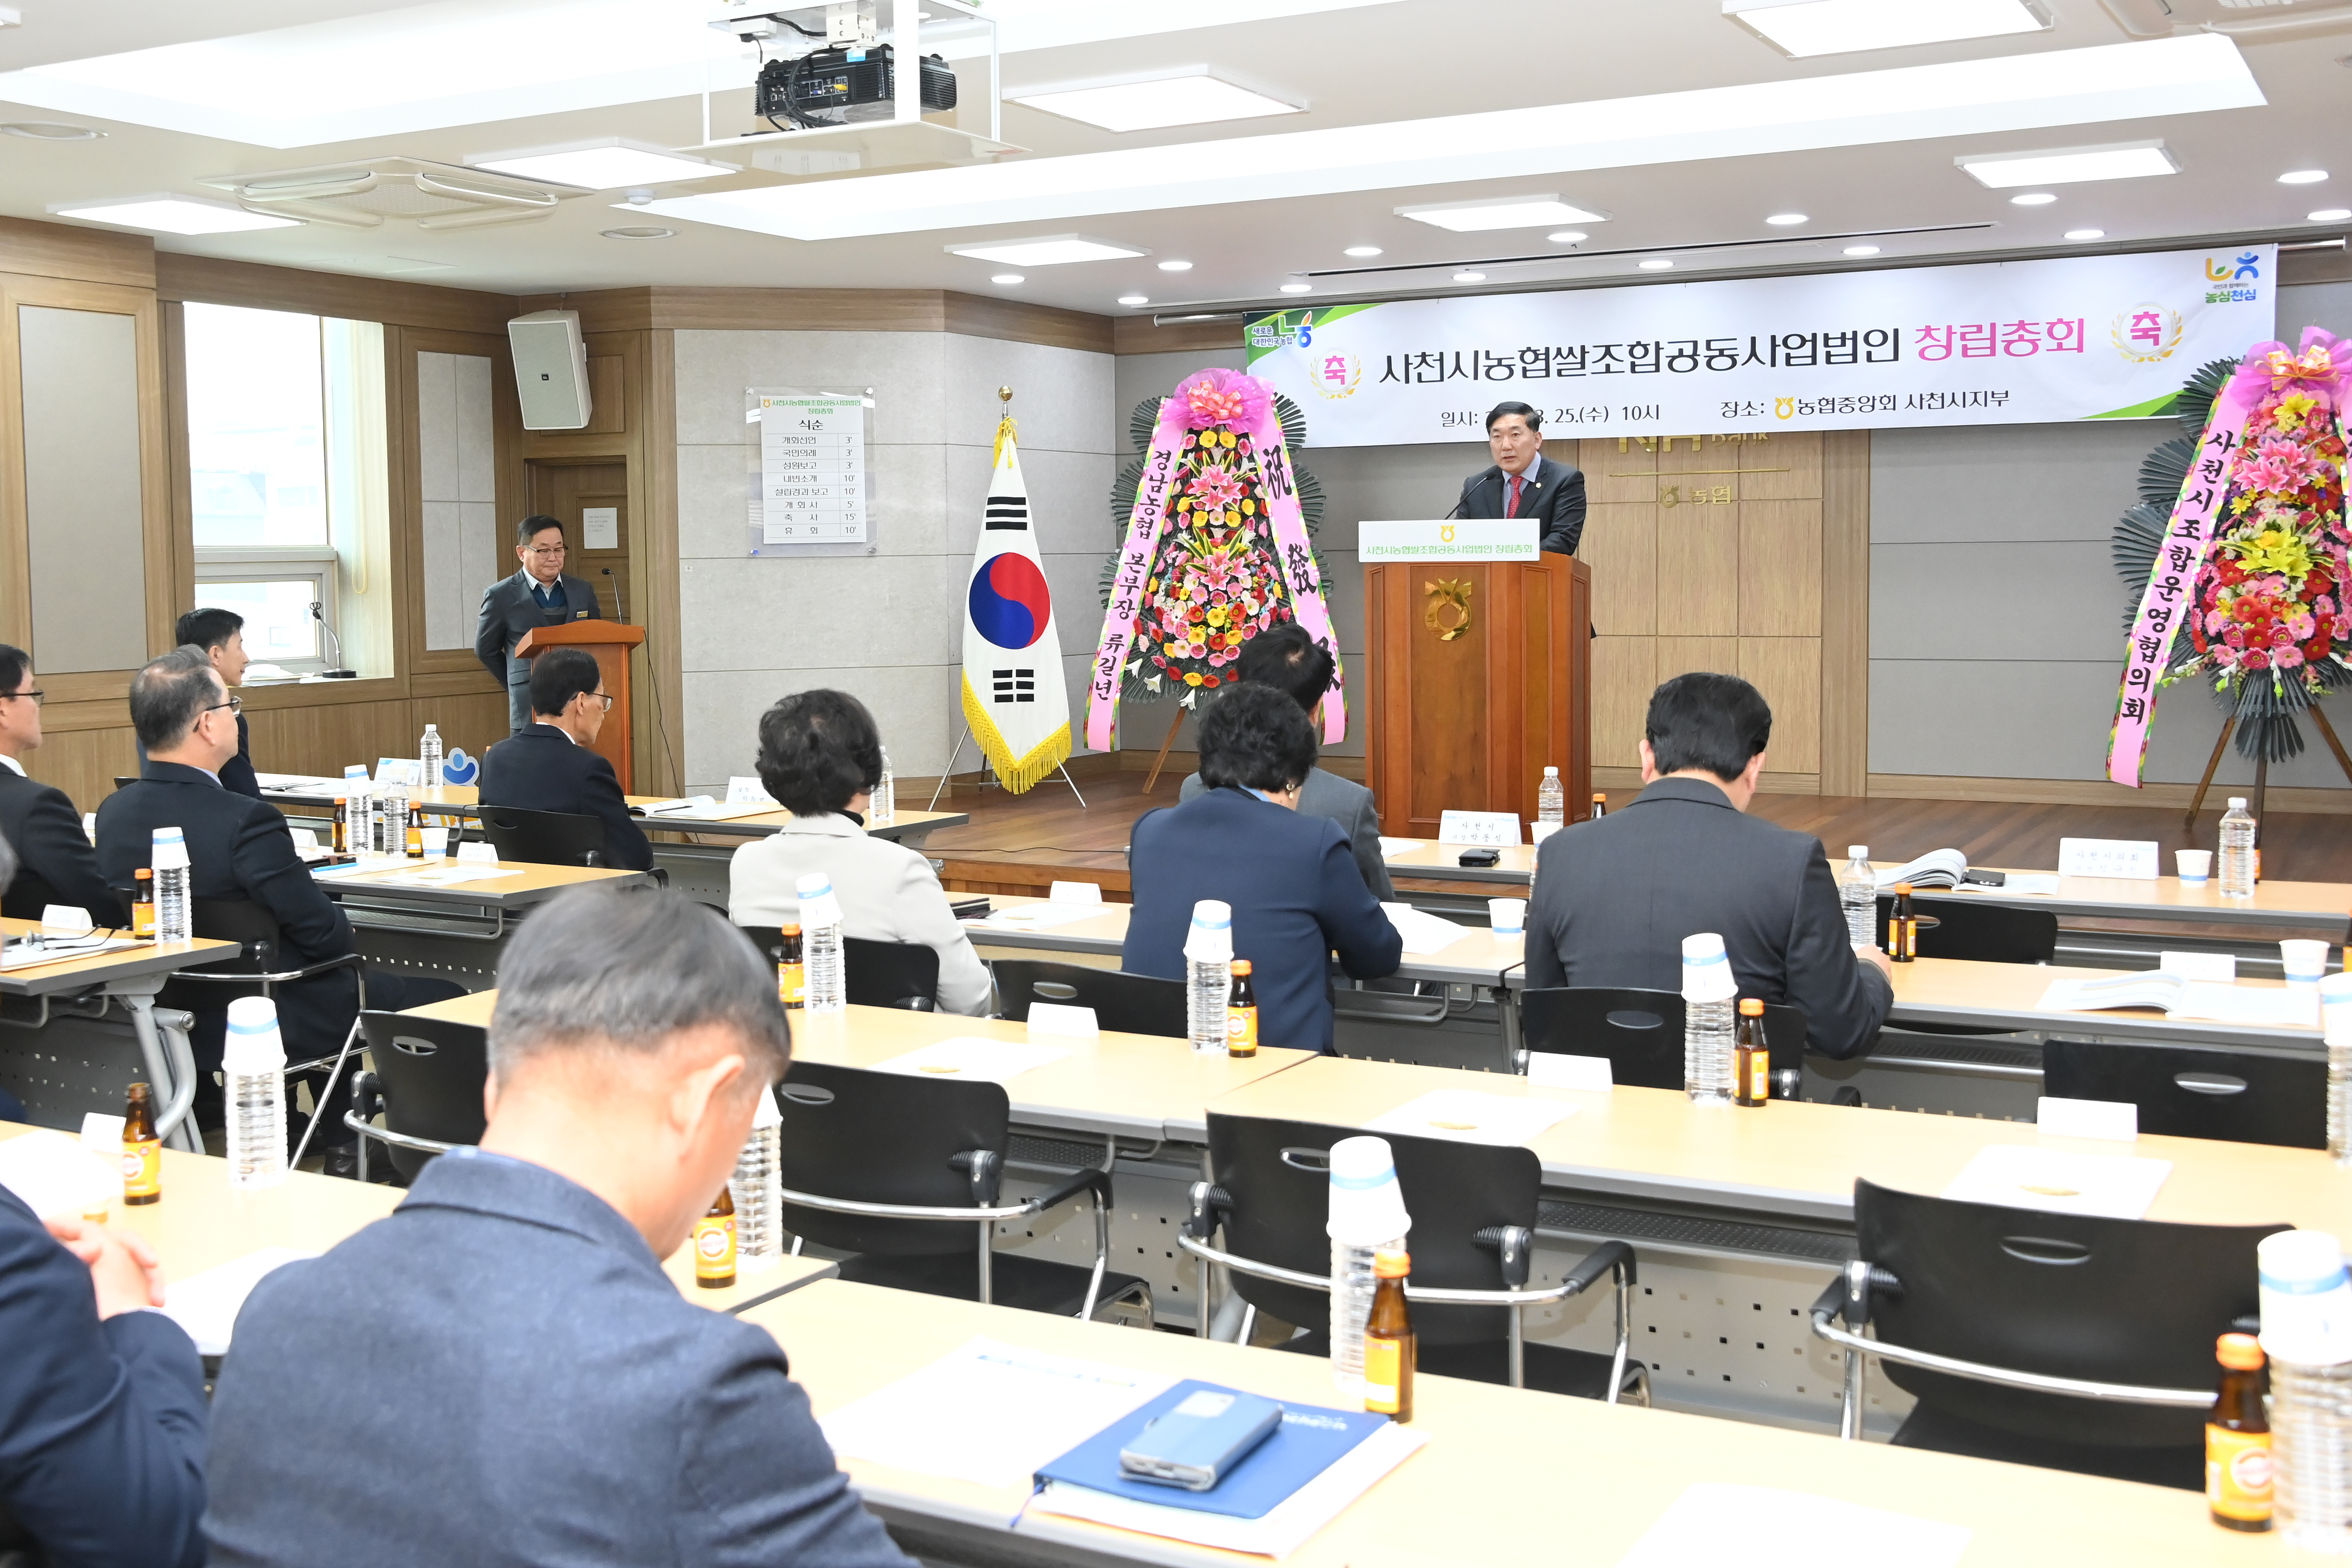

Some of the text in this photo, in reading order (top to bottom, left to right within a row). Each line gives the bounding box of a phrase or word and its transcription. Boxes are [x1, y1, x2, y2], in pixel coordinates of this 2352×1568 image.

[2205, 289, 2257, 304] 농심천심
[1252, 327, 1274, 335] 새로운
[2130, 311, 2161, 347] 축
[1252, 338, 1280, 346] 대한민국
[1379, 318, 2084, 384] 사천시농협쌀조합공동사업법인 창립총회
[1324, 355, 1346, 386] 축
[1720, 390, 2009, 418] 장소: 농협중앙회 사천시지부
[1441, 411, 1478, 427] 일시:
[1554, 406, 1609, 423] 25.(수)
[1622, 404, 1659, 420] 10시
[799, 419, 823, 430] 식순
[782, 436, 816, 444] 개회선언
[783, 449, 816, 457] 국민의례
[783, 462, 817, 470] 성원보고
[784, 475, 817, 483] 내빈소개
[775, 488, 808, 496] 설립경과
[1689, 485, 1731, 505] 농협
[1366, 544, 1532, 555] 사천시농협쌀조합공동사업법인 창립총회
[1095, 449, 1172, 700] 경남농협 본부장 류길년
[2122, 430, 2236, 726] 사천시조합운영협의회
